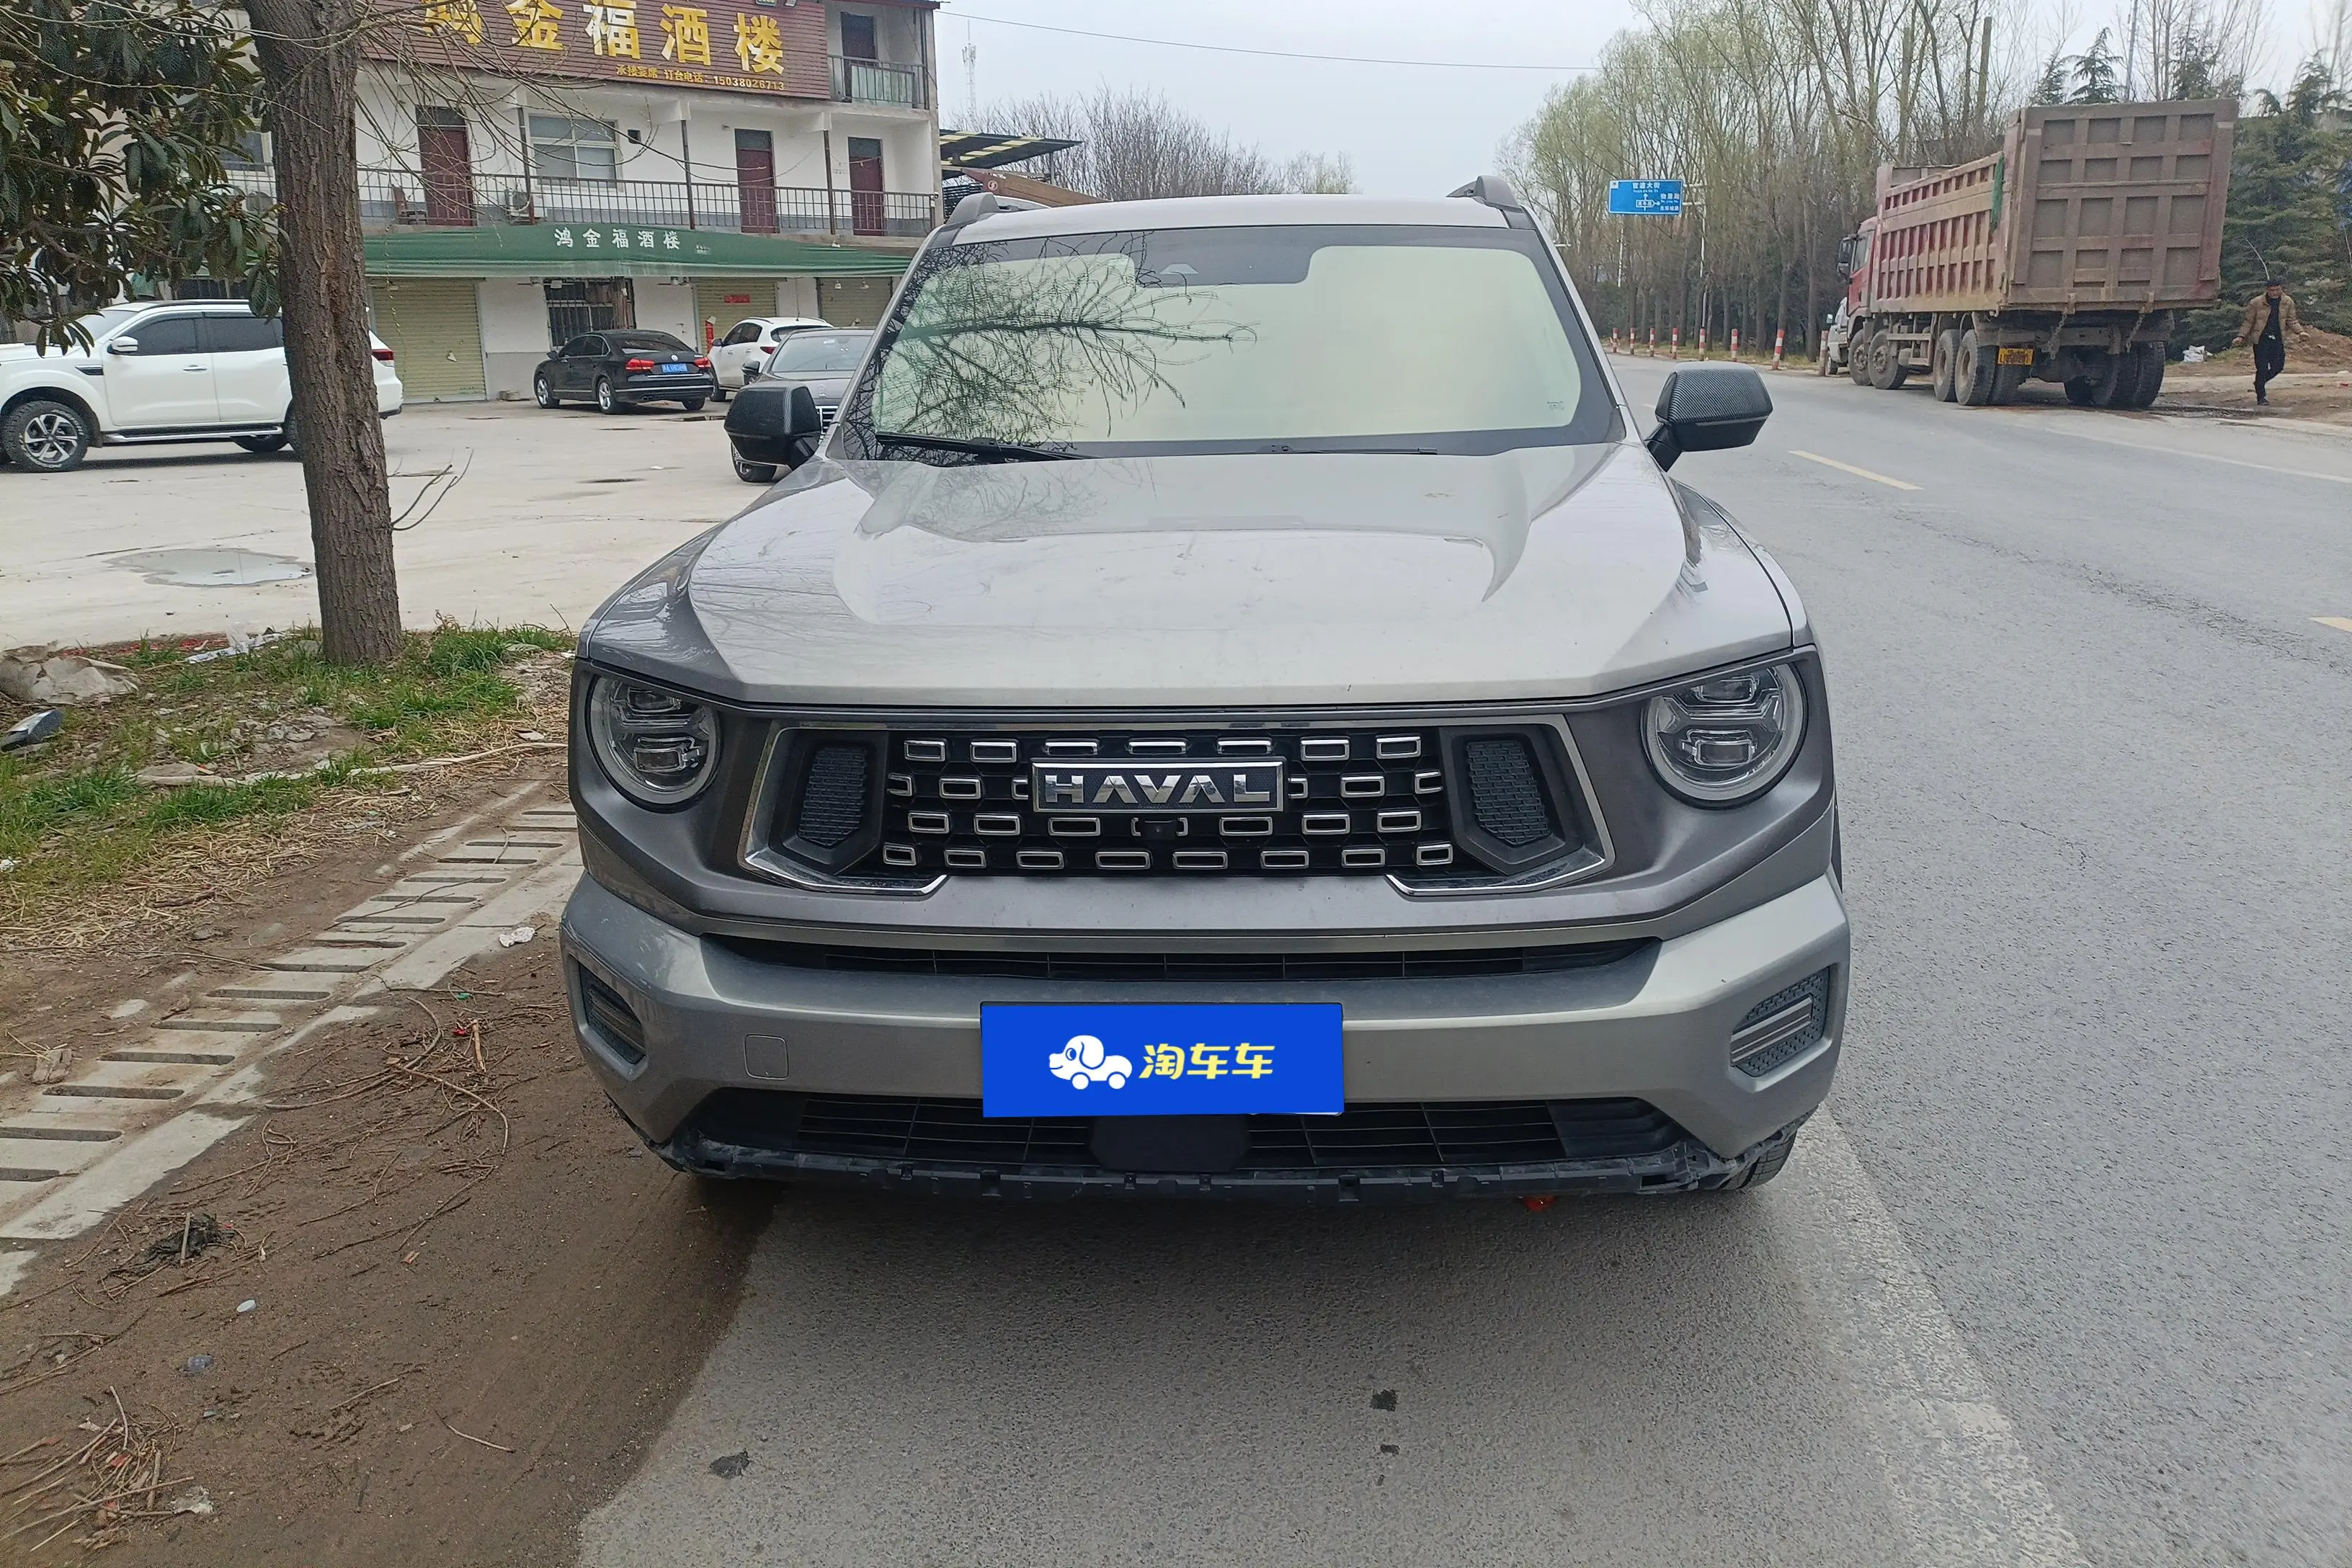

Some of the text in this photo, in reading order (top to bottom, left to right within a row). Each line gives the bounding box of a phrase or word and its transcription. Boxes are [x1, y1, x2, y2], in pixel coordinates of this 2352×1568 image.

[713, 75, 785, 91] 15038026713
[553, 226, 680, 250] 鸿金福酒楼
[1044, 774, 1270, 803] HAVAL
